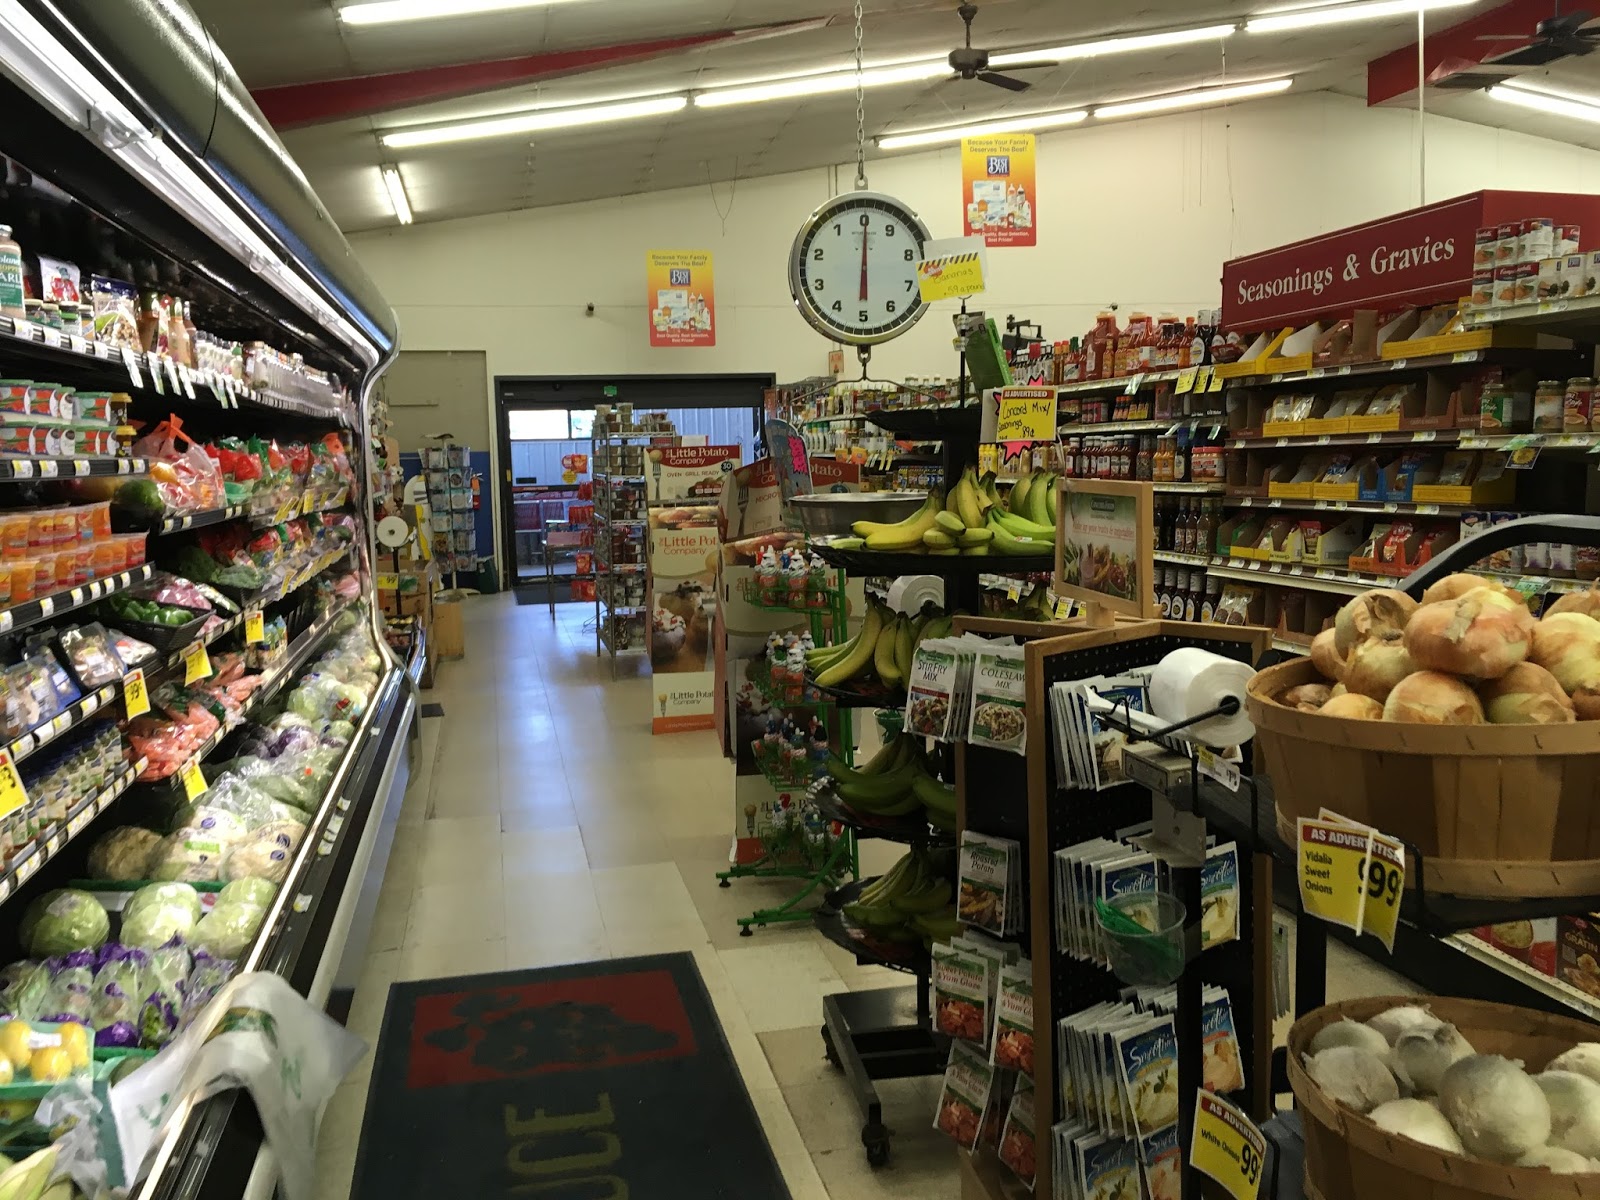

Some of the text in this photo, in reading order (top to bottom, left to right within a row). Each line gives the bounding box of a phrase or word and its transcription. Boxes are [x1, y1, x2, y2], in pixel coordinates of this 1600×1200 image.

[860, 214, 869, 227] 0
[833, 224, 841, 236] 1
[885, 225, 895, 236] 9
[814, 249, 824, 260] 2
[904, 249, 914, 261] 8
[1238, 236, 1454, 304] Seasonings & Gravies
[814, 279, 824, 290] 3
[904, 280, 913, 292] 7
[832, 300, 842, 312] 4
[886, 300, 895, 312] 6
[859, 311, 868, 322] 5
[1003, 400, 1027, 419] Concord
[670, 448, 696, 458] Little
[698, 447, 729, 457] Potato
[810, 463, 842, 477] otato
[665, 536, 696, 547] Little
[918, 660, 948, 674] STIR FRY
[923, 672, 938, 681] MIX
[980, 667, 1025, 681] COLESLAW
[995, 681, 1012, 689] MIX
[1311, 828, 1326, 841] AS
[1305, 851, 1332, 865] Vidalia
[1305, 866, 1330, 878] Sweet
[1305, 880, 1332, 895] Onions
[1209, 1102, 1222, 1116] AS
[1201, 1128, 1220, 1147] White
